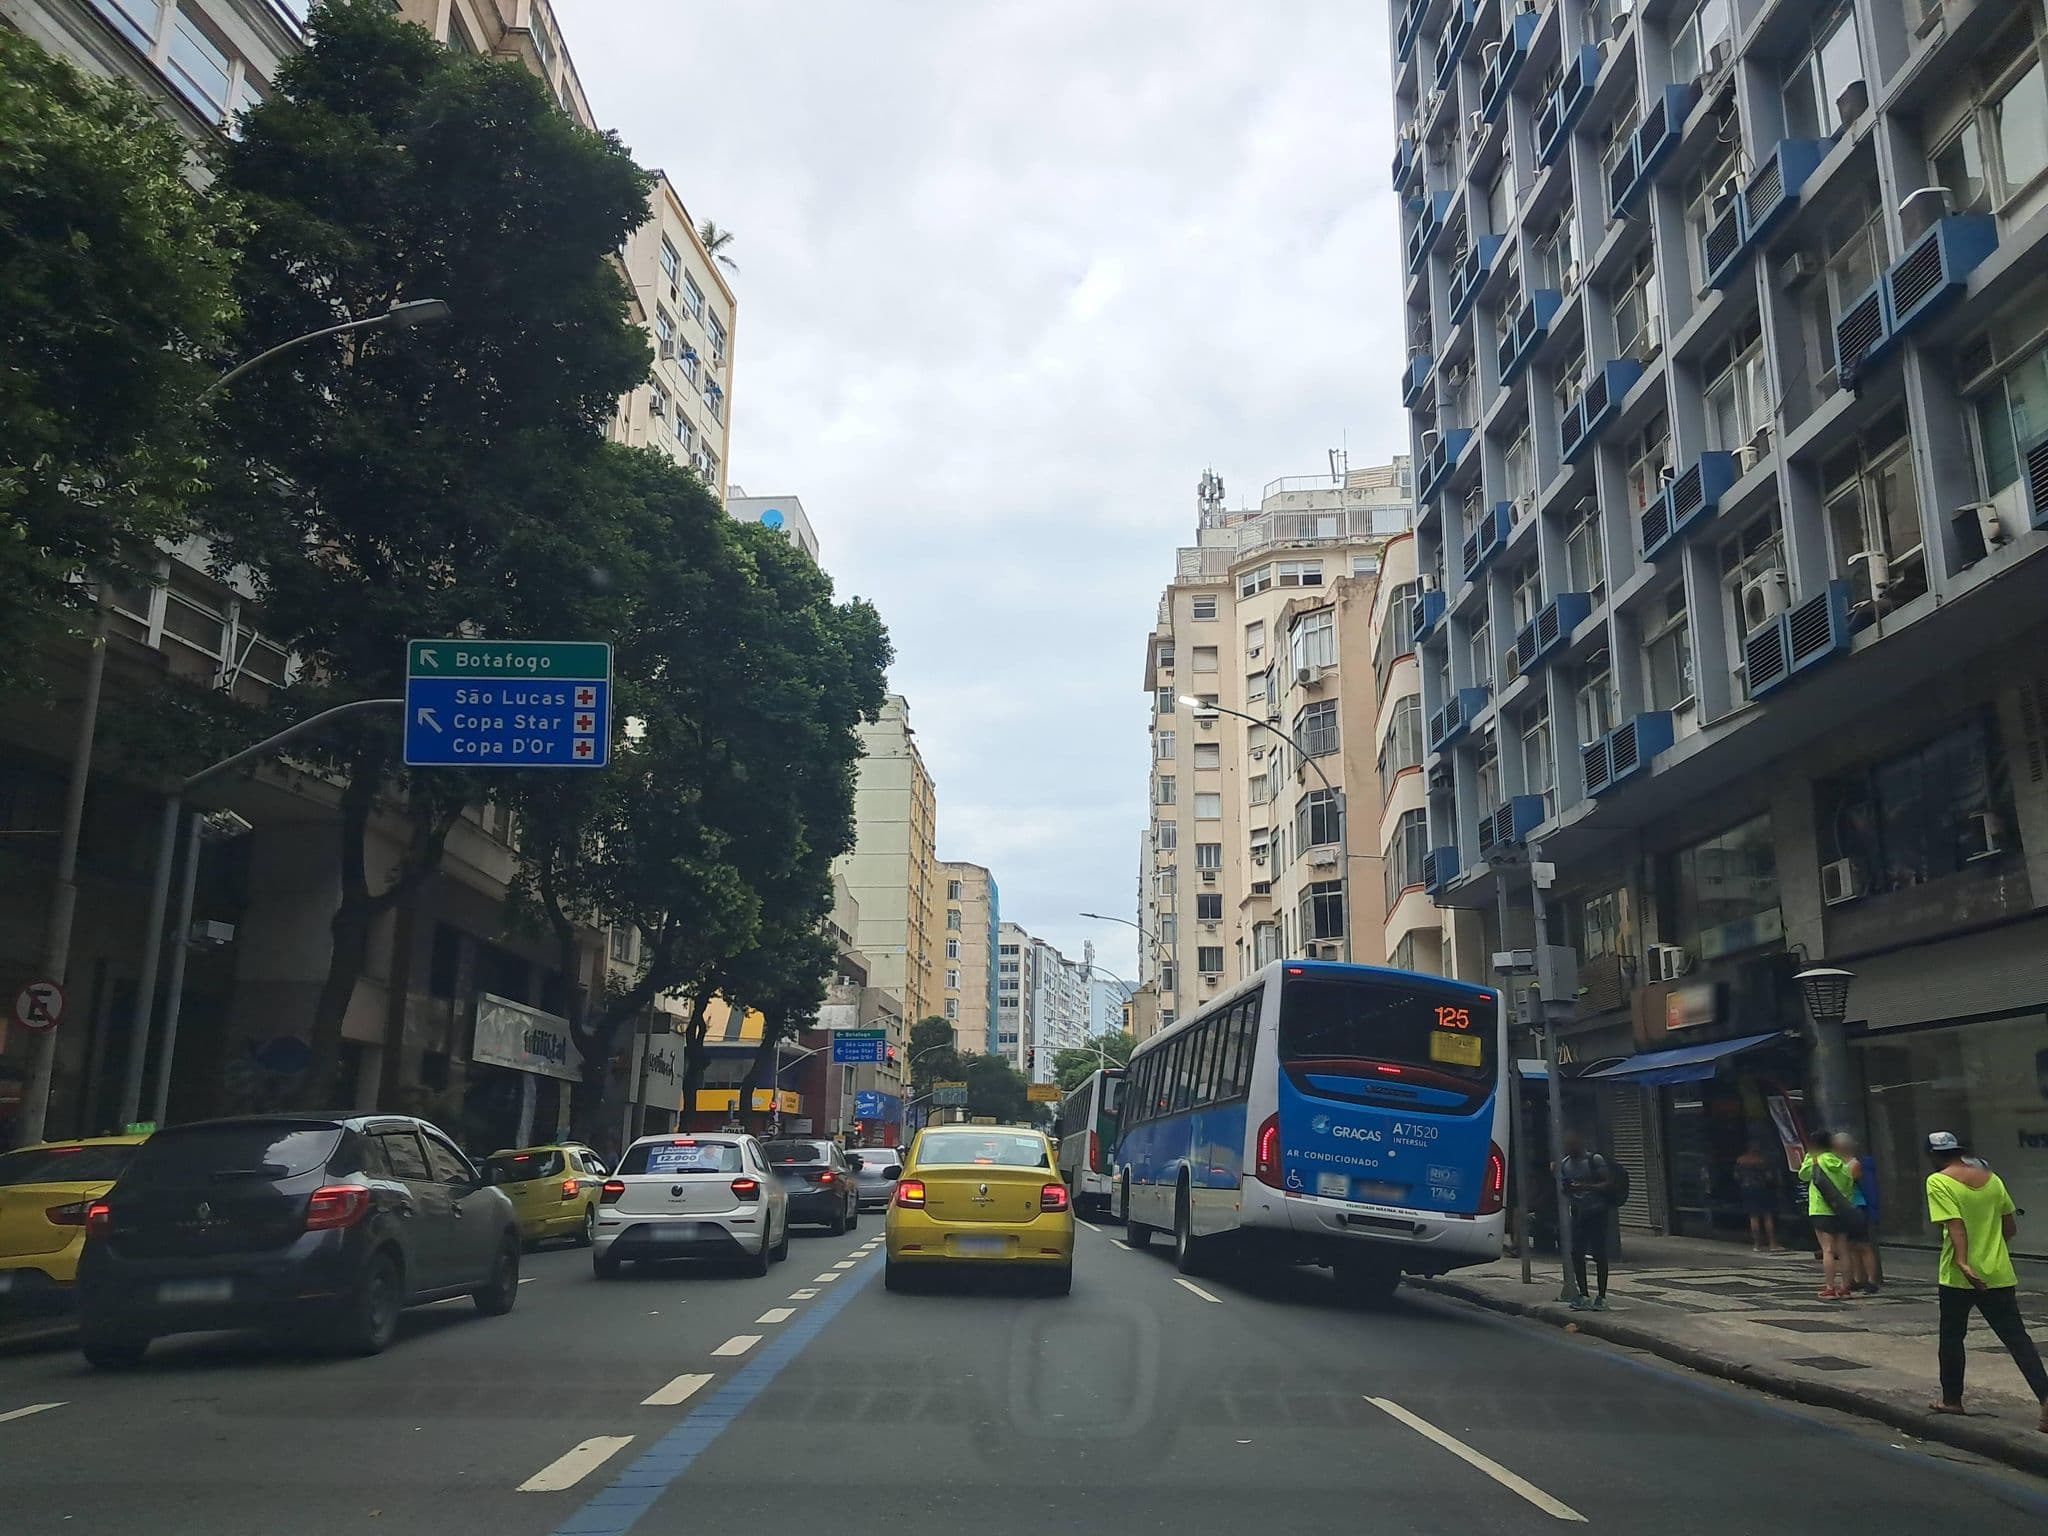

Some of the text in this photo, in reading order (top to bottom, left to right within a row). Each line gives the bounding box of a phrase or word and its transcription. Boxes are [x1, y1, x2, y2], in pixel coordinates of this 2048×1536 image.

[455, 652, 551, 672] Botafogo
[455, 688, 566, 706] São Lucas
[453, 714, 562, 732] Copa Star
[452, 738, 556, 756] Copa D'Or
[1434, 1006, 1469, 1029] 125
[1332, 1125, 1382, 1142] GRAÇAS
[1393, 1137, 1428, 1148] INTERSUL
[1286, 1149, 1379, 1168] AR CONDICIONADO
